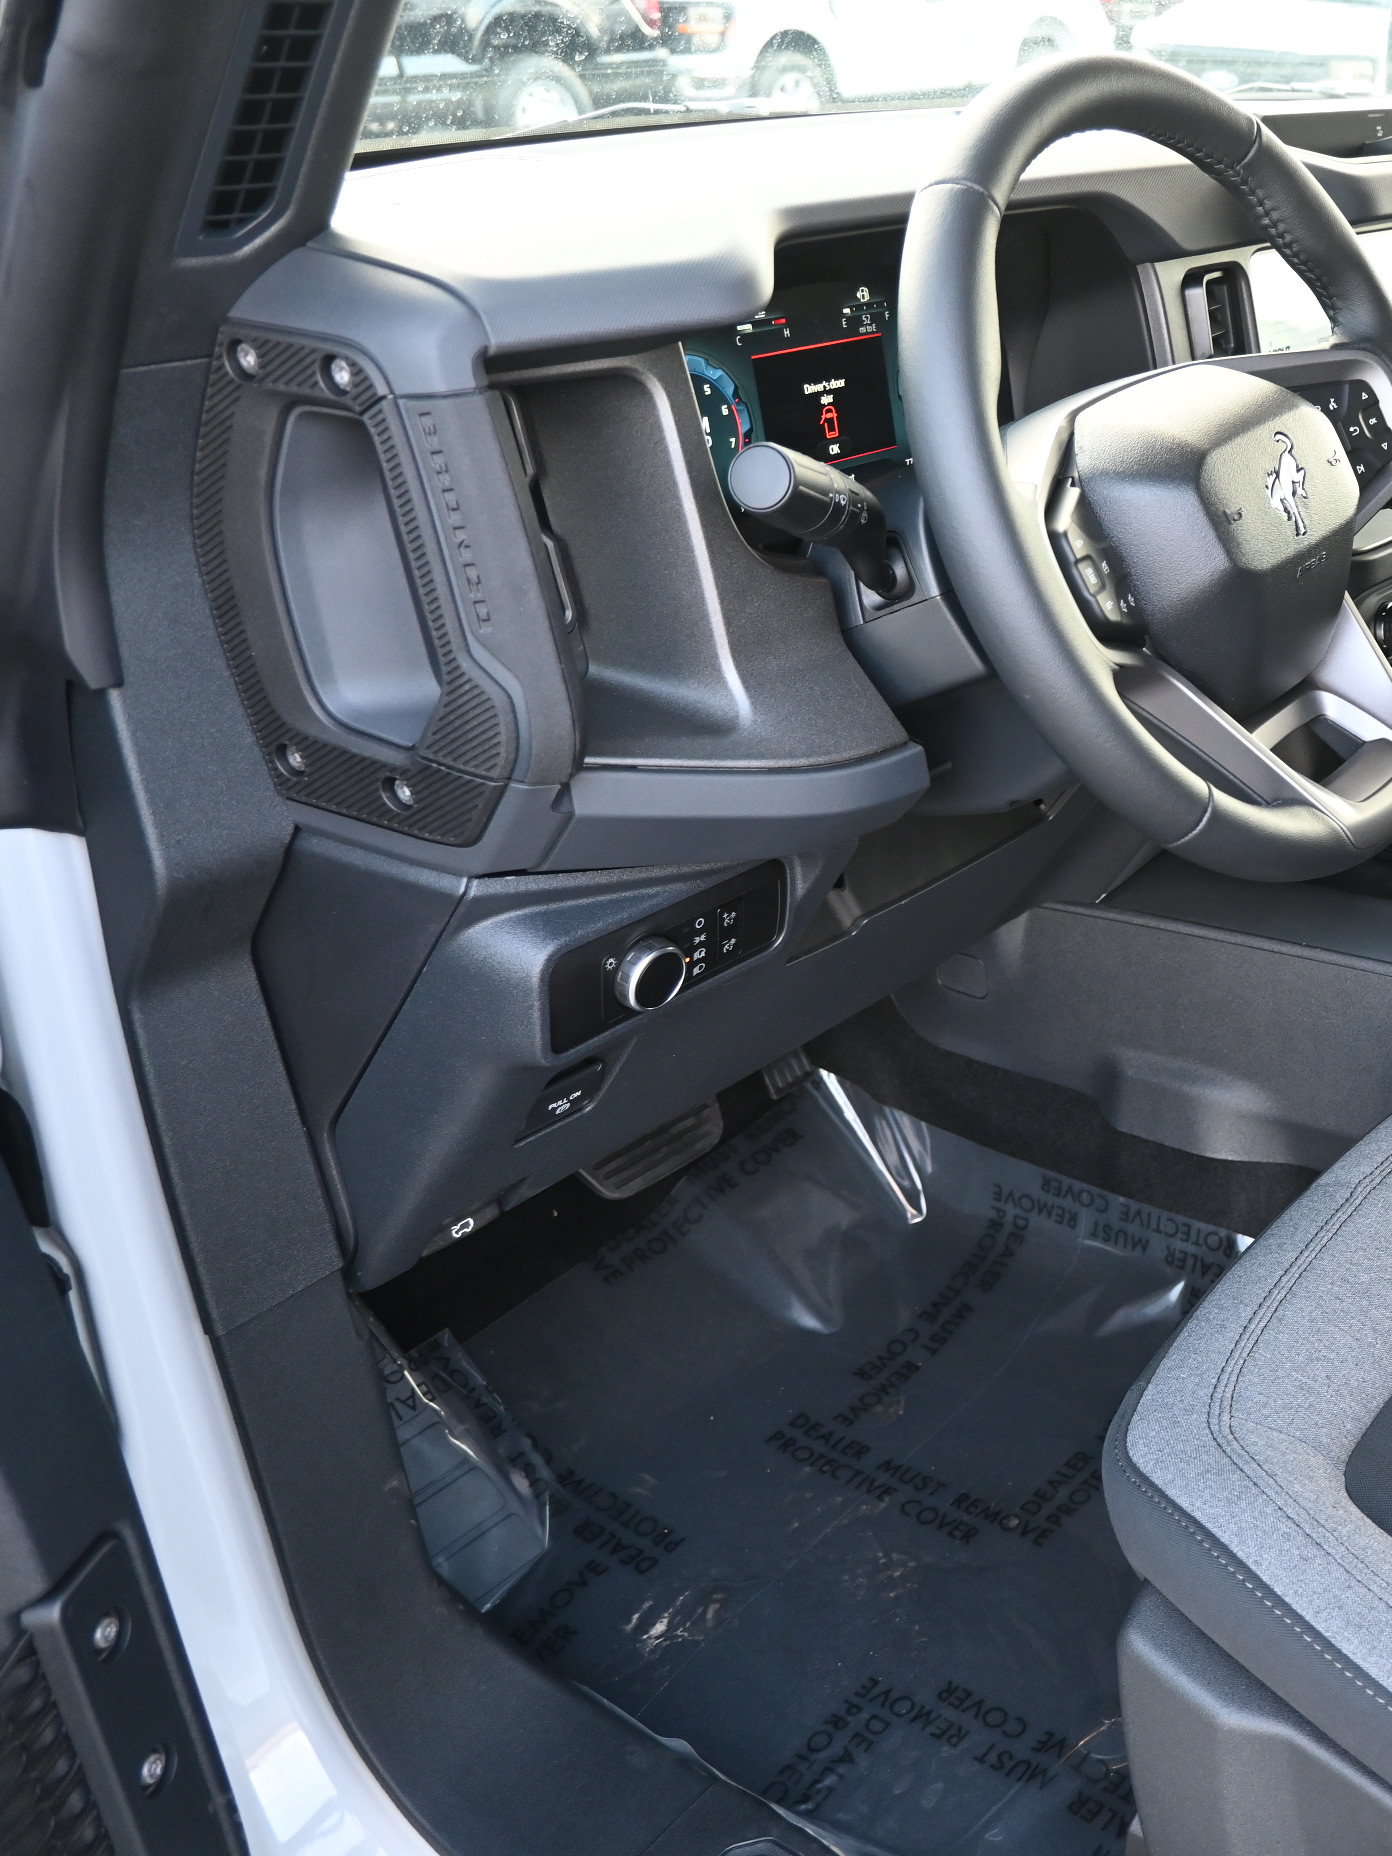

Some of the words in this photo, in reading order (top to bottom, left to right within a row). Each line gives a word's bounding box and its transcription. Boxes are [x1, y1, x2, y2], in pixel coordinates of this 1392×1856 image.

[736, 336, 742, 346] C
[784, 328, 791, 338] H
[862, 314, 872, 325] 52
[703, 384, 711, 395] 5
[721, 404, 729, 416] 6
[804, 379, 830, 395] Driver's
[830, 378, 846, 390] door
[820, 394, 834, 405] ajar
[730, 438, 736, 448] 7
[829, 443, 841, 455] OK
[418, 411, 494, 634] BRONCO
[548, 1097, 568, 1110] PULL
[569, 1090, 582, 1100] ON
[993, 1181, 1079, 1230] REMOVE
[1040, 1173, 1110, 1215] COVER
[975, 1213, 1030, 1293] DEALER
[1090, 1219, 1150, 1255] MUST
[1118, 1202, 1237, 1260] ROTECTIVE
[853, 1328, 921, 1382] COVER
[920, 1301, 974, 1358] MUST
[832, 1359, 923, 1428] REMOVE
[763, 1428, 899, 1503] PROTECTIVE
[900, 1498, 981, 1547] COVER
[787, 1412, 872, 1463] DEALER
[874, 1457, 949, 1498] MUST
[950, 1491, 1052, 1549] REMOVE
[1018, 1450, 1098, 1517] DEALER
[571, 1517, 660, 1574] DEALER
[509, 1558, 610, 1647] EMOVE
[854, 1676, 971, 1748] REMOVE
[936, 1679, 1028, 1738] COVER
[761, 1699, 864, 1803] PROTEC
[973, 1743, 1058, 1791] MUST
